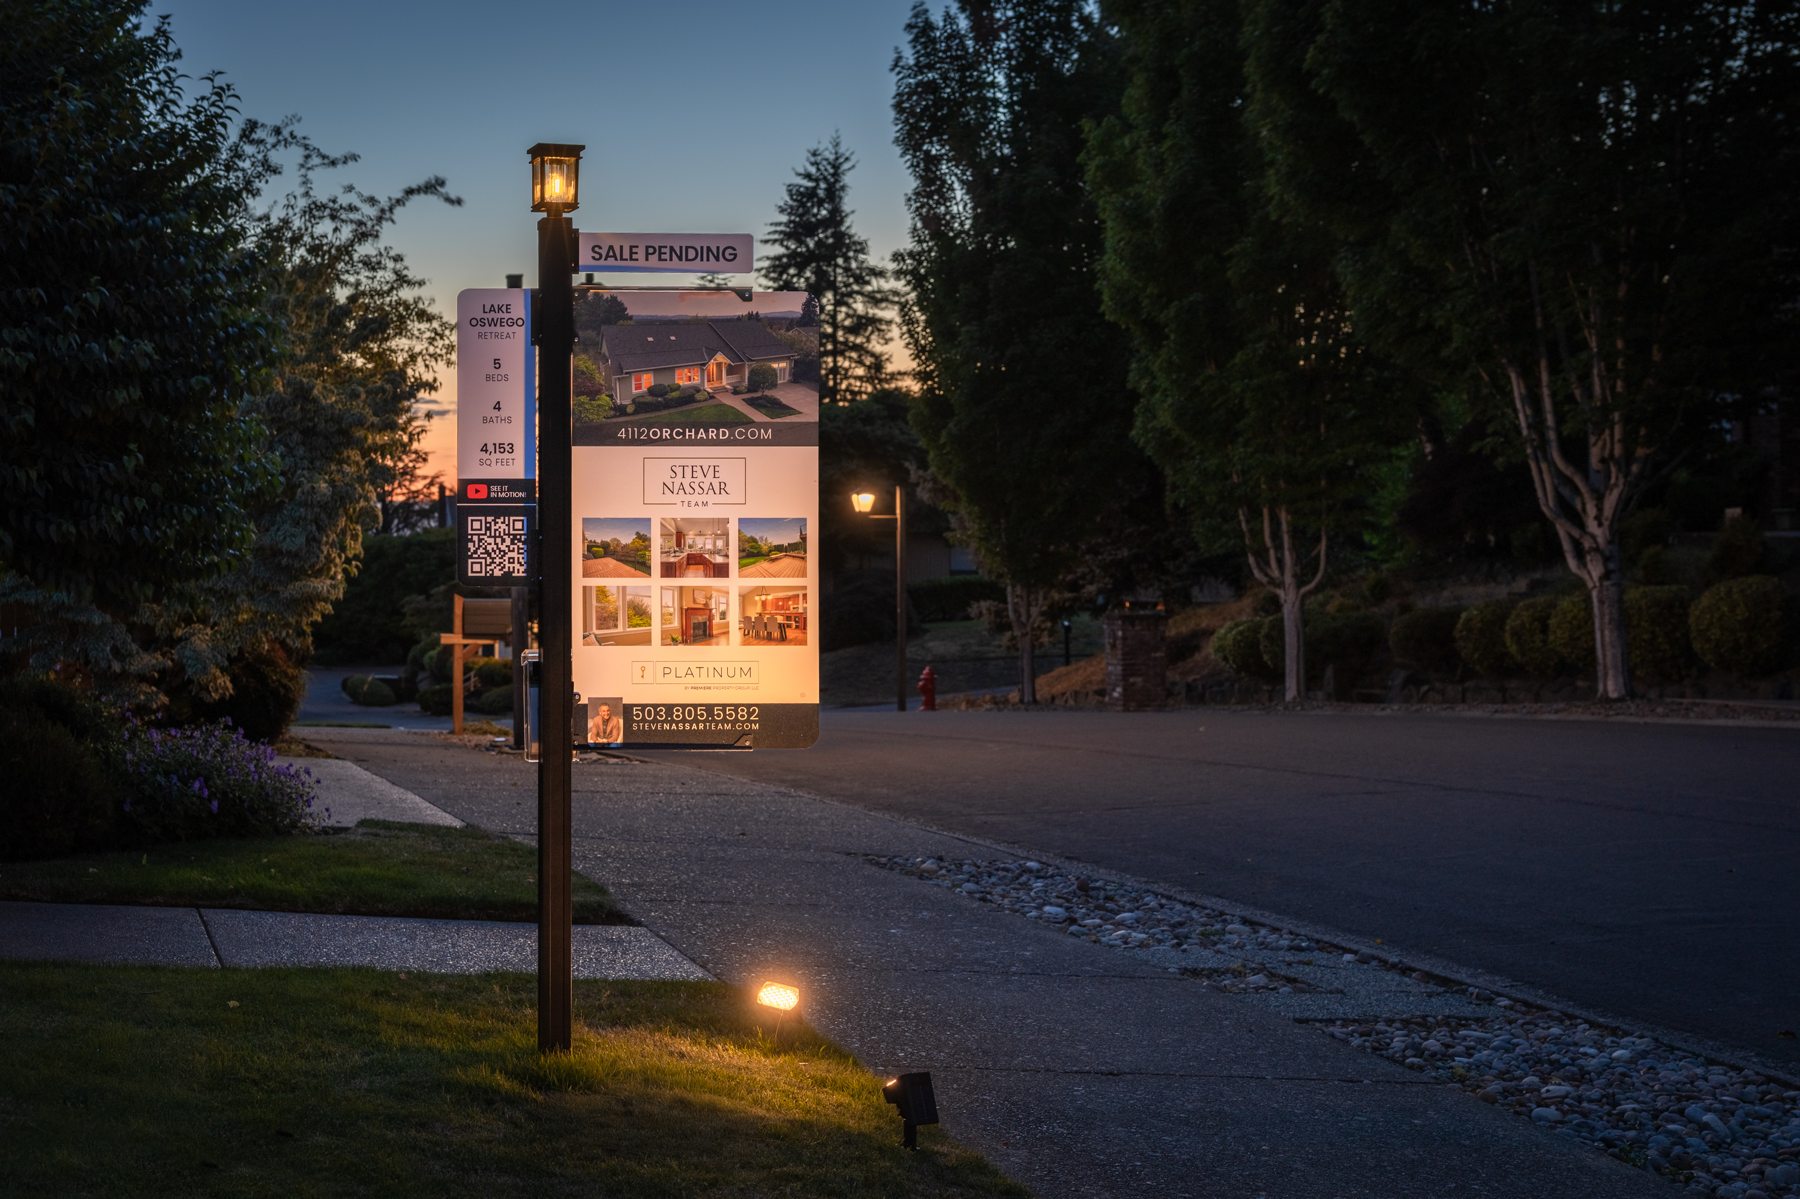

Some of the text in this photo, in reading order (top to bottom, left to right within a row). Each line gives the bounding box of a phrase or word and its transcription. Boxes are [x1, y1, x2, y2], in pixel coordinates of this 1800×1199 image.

[591, 245, 738, 261] SALE PENDING
[482, 304, 511, 314] LAKE
[469, 317, 525, 328] OSWEGO
[477, 331, 516, 340] RETREAT
[493, 358, 501, 370] 5
[485, 373, 509, 382] BEDS
[492, 401, 502, 412] 4
[482, 416, 512, 424] BATHS
[617, 427, 773, 440] 4112ORCHARD.COM
[480, 443, 515, 455] 4,153
[479, 458, 516, 467] SQ FEET
[669, 465, 721, 479] STEVE
[662, 481, 730, 495] NASSAR
[662, 666, 753, 679] PLATINUM
[632, 706, 760, 721] 503.805.5582
[632, 722, 760, 730] STEVENASSARTEAM.COM
